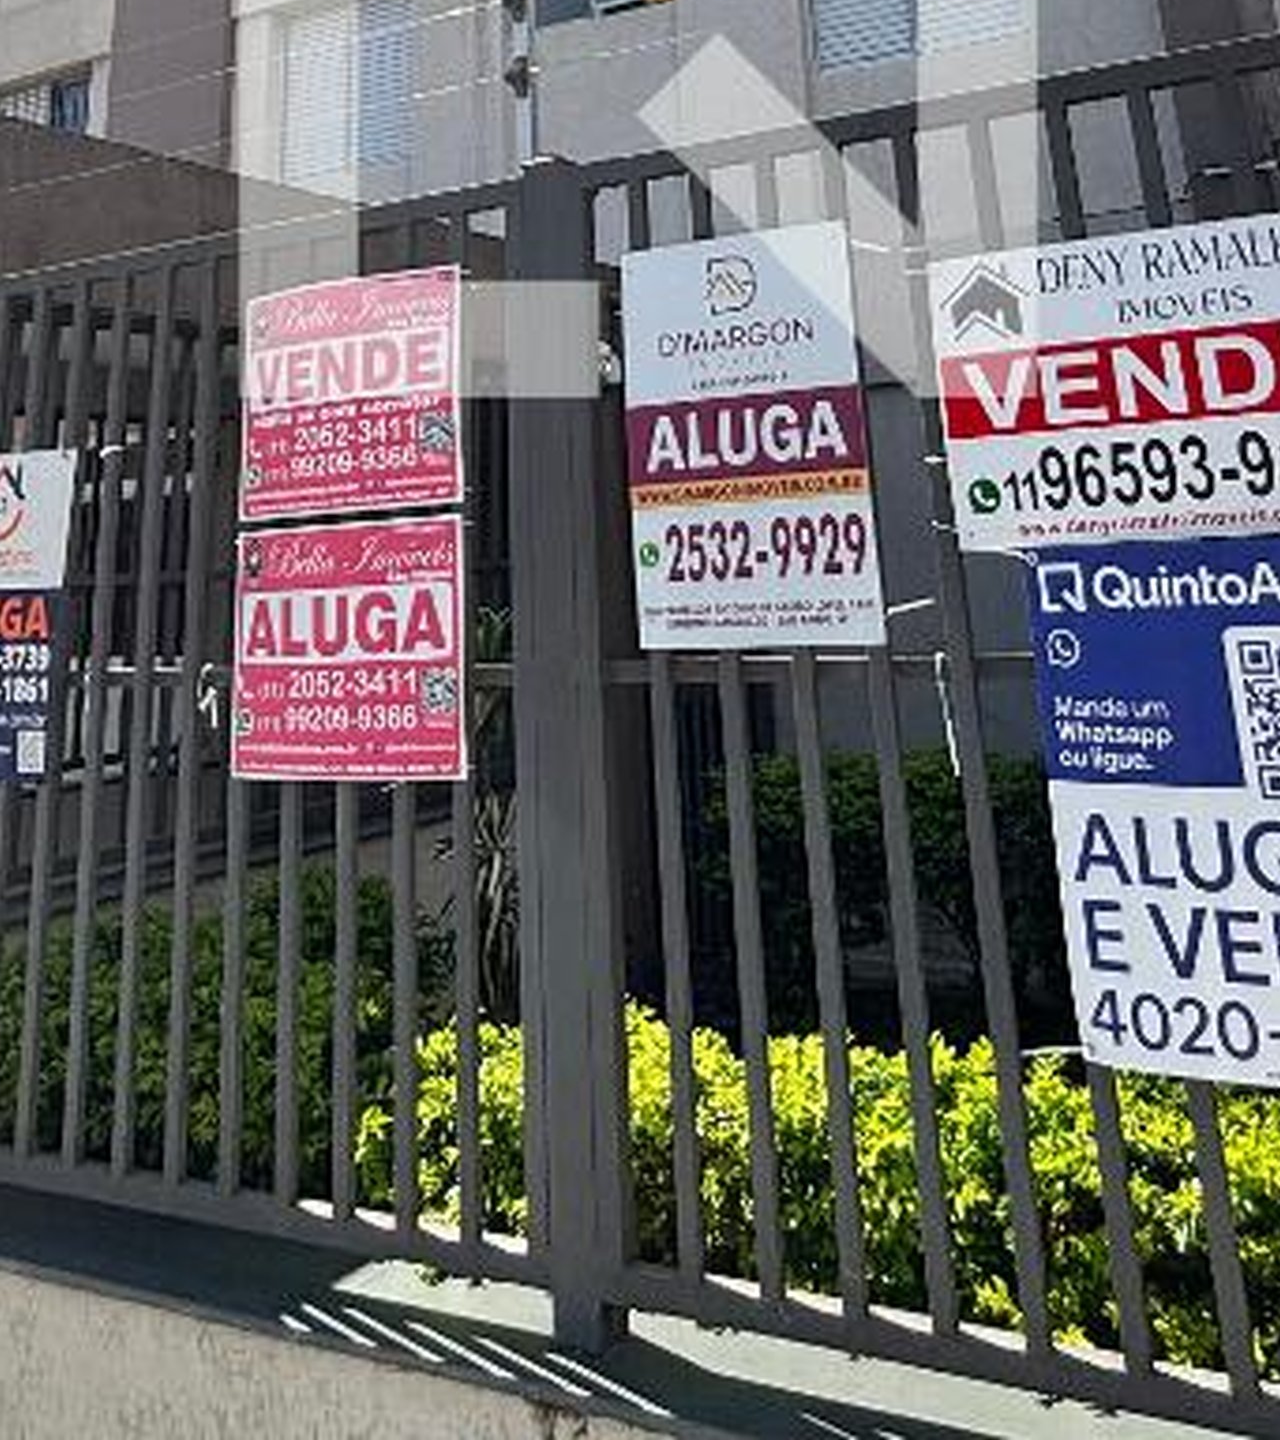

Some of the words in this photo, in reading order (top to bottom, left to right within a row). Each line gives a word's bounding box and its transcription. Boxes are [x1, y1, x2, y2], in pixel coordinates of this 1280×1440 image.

[1036, 245, 1129, 293] DENY
[255, 331, 442, 406] VENDE
[647, 400, 847, 474] ALUGA
[665, 512, 866, 583] 2532-9929
[247, 587, 446, 657] ALUGA
[1054, 696, 1129, 718] Manda
[1131, 700, 1171, 719] um
[1055, 719, 1174, 751] Whatsapp
[1059, 749, 1088, 769] ou
[1082, 899, 1131, 973] E
